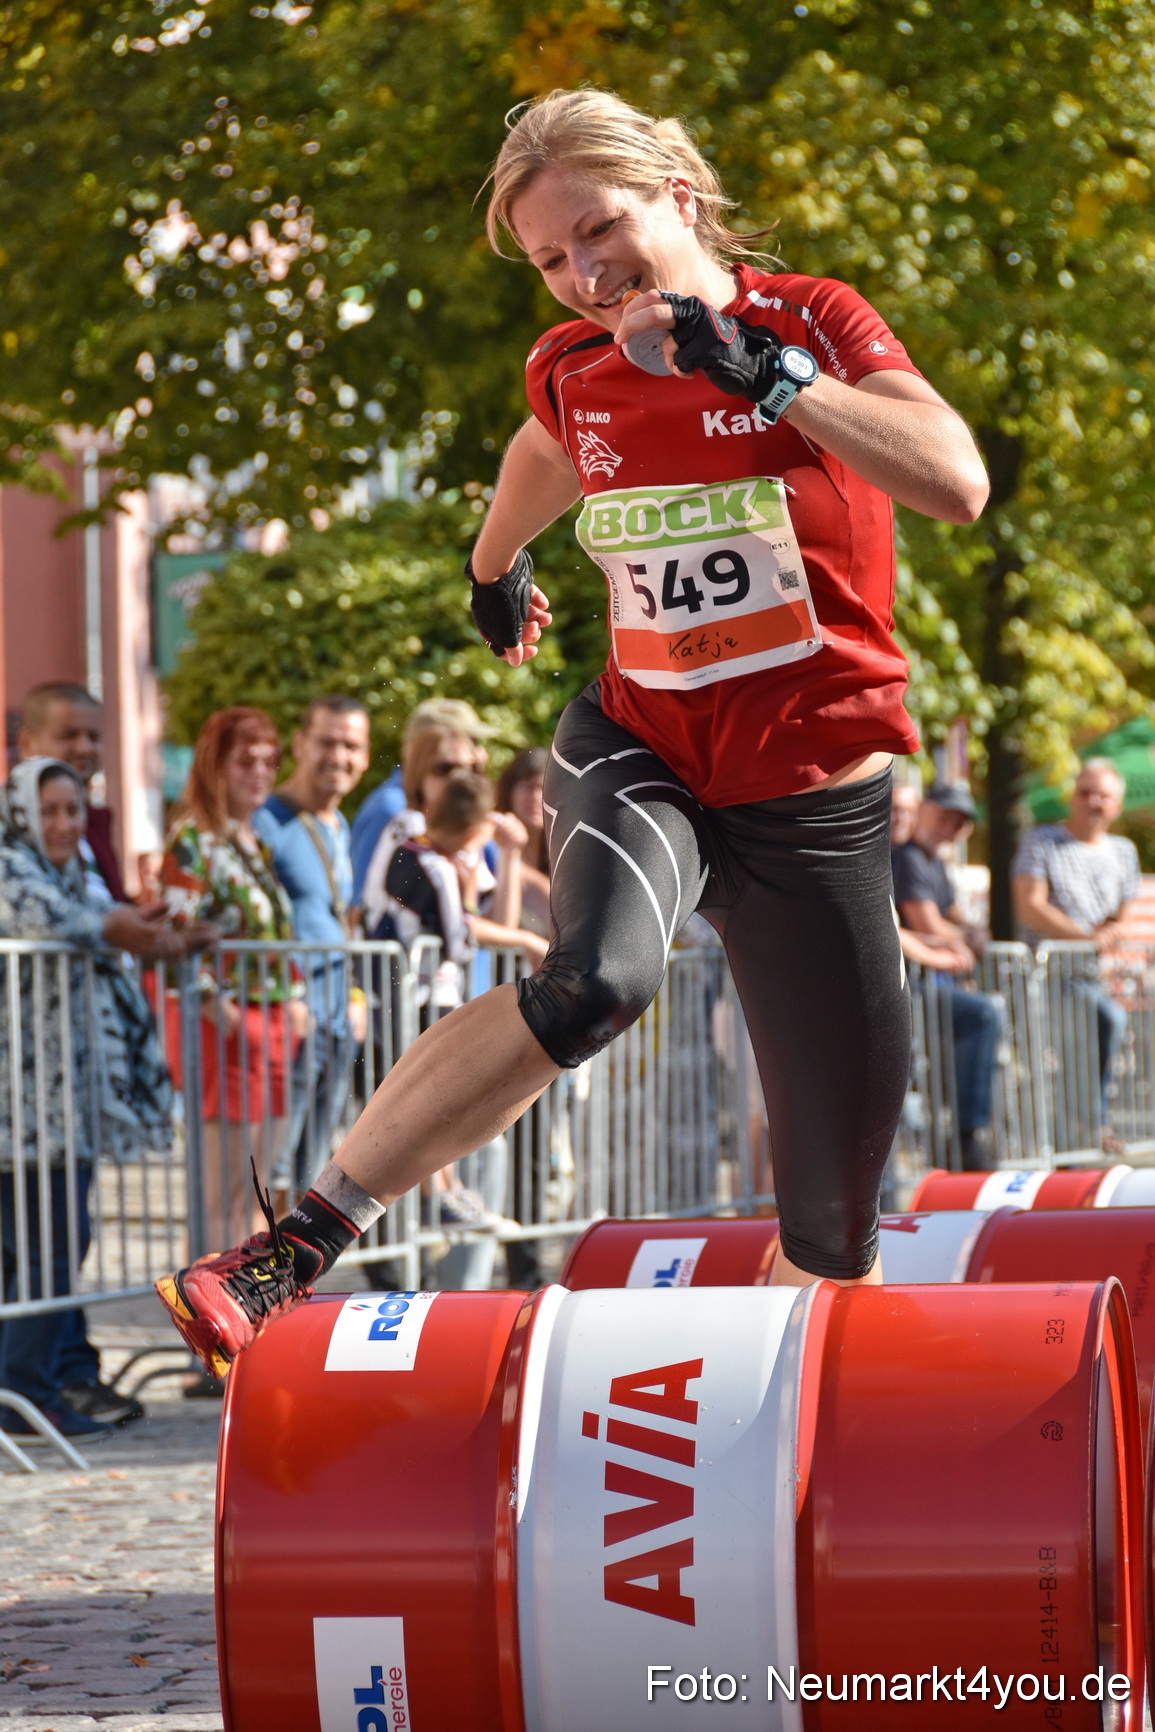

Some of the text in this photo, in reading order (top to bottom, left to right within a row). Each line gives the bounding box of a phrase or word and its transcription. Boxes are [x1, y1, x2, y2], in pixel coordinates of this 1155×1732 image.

[585, 411, 611, 424] JAKO
[590, 485, 757, 543] BOCK
[771, 542, 788, 550] E11
[625, 550, 750, 620] 549
[669, 631, 739, 660] Katja
[1045, 1319, 1065, 1345] 323
[1039, 1546, 1060, 1663] 12414-B&B
